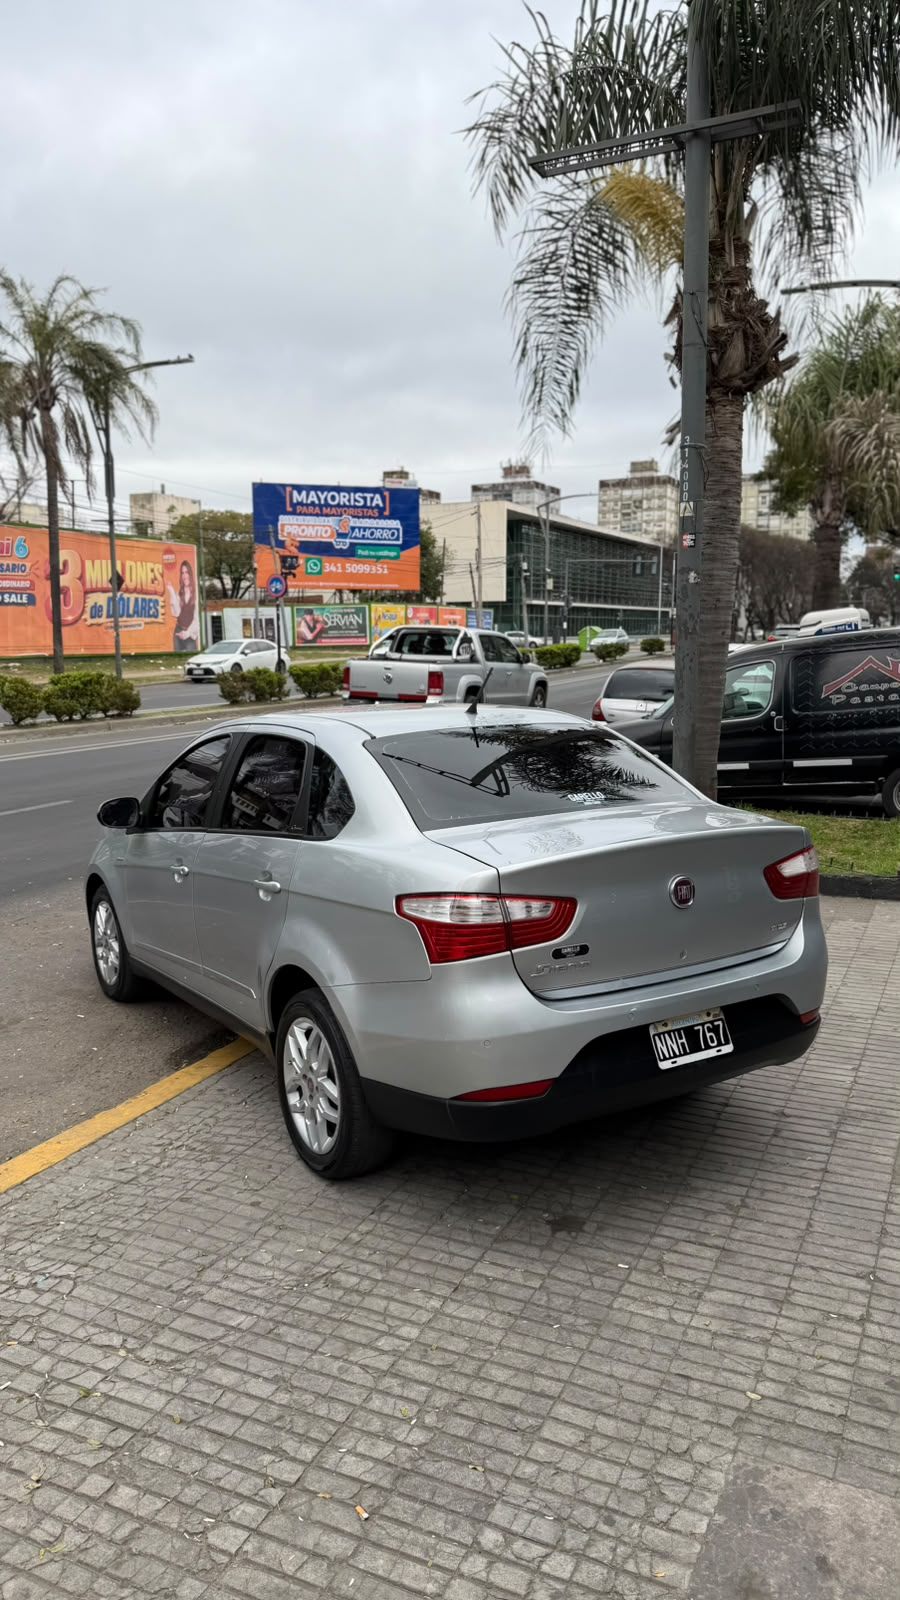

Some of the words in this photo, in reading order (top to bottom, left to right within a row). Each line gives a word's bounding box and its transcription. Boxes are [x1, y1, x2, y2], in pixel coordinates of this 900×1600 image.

[292, 489, 384, 508] MAYORISTA
[296, 506, 321, 516] PARA
[322, 507, 379, 518] MAYORISTAS
[284, 525, 332, 538] PRONTO
[351, 528, 398, 540] AHORRO
[14, 535, 29, 559] 6
[324, 562, 342, 572] 341
[345, 563, 389, 575] 5099351
[3, 593, 28, 604] SALE
[90, 602, 104, 619] de
[677, 884, 692, 901] FIAT
[654, 1029, 690, 1060] NNH
[693, 1020, 726, 1050] 767
